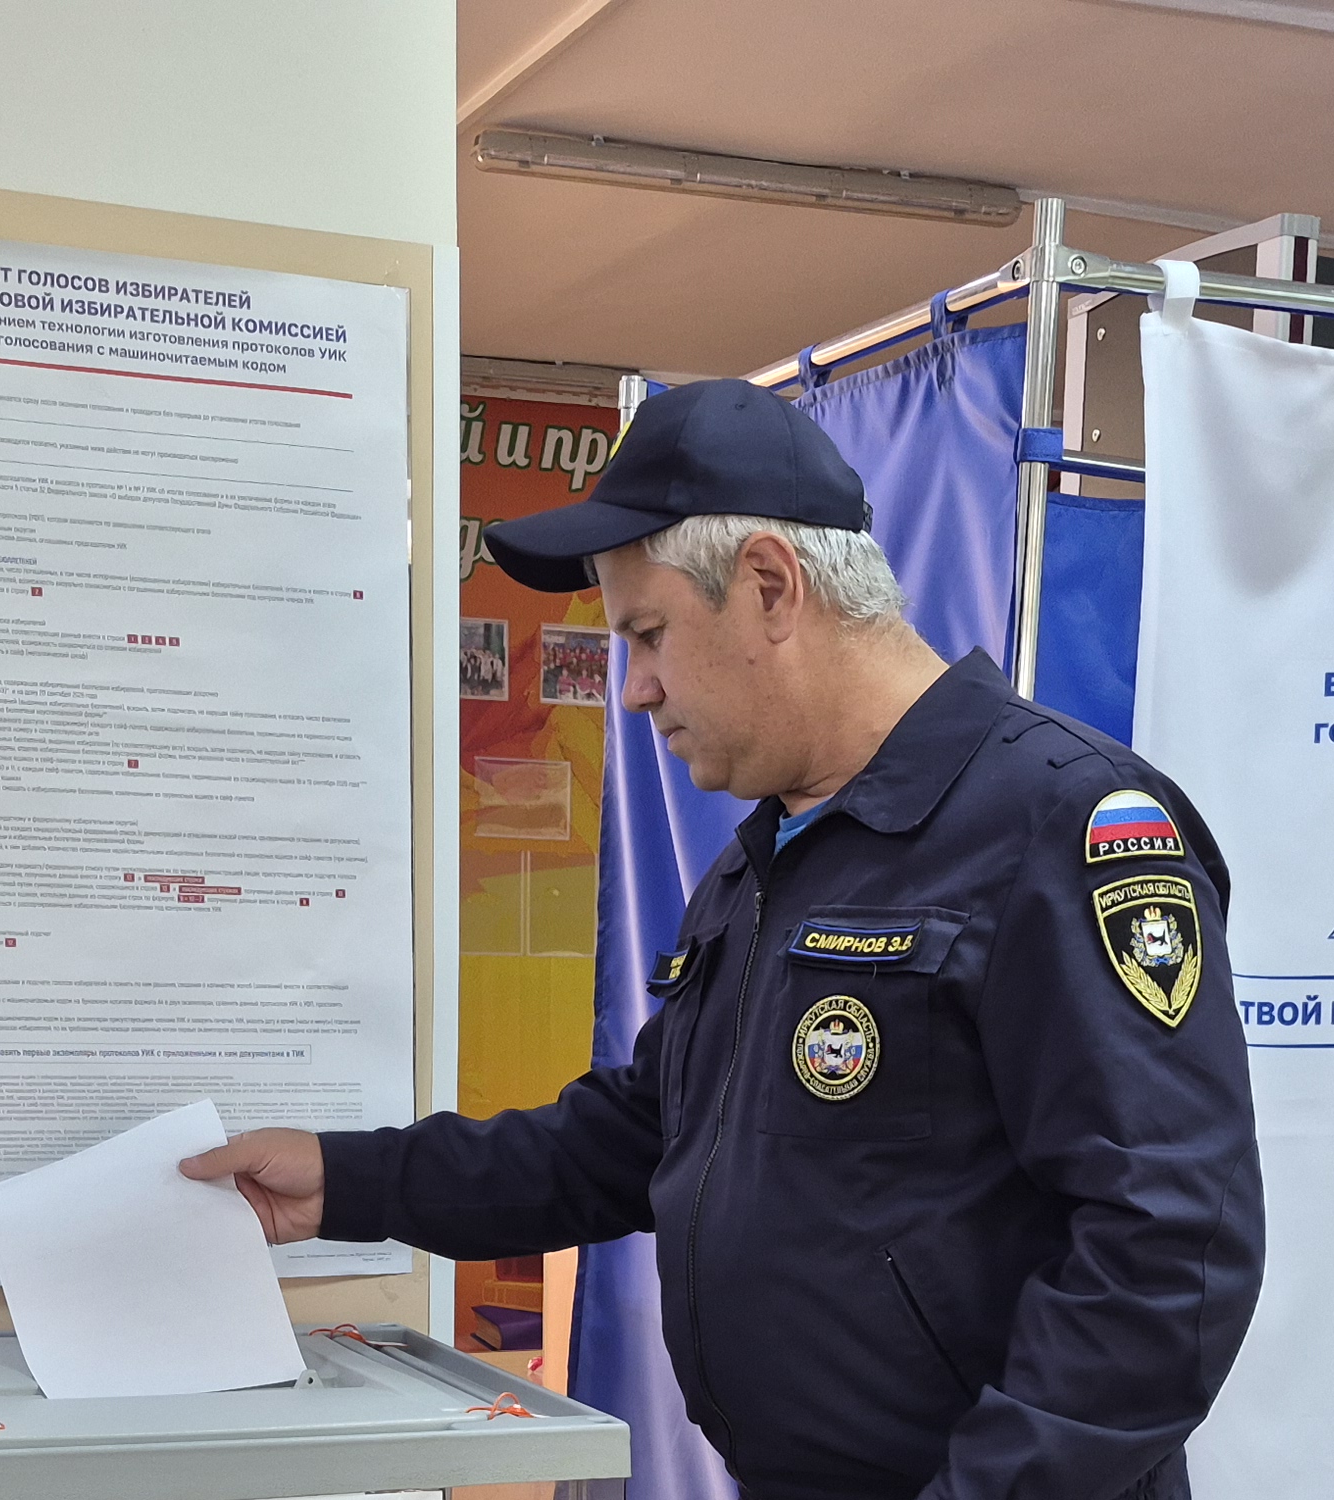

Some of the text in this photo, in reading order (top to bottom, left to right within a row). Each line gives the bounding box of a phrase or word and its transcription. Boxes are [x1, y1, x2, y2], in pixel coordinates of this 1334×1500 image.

[17, 269, 110, 294] ГОЛОСОВ
[115, 279, 252, 311] ИЗБИРАТЕЛЕЙ
[60, 297, 227, 331] ИЗБИРАТЕЛЬНОЙ
[231, 317, 347, 343] КОМИССИЕЙ
[40, 319, 125, 339] технологии
[129, 330, 228, 350] изготовления
[232, 340, 315, 358] протоколов
[318, 347, 347, 362] УИК
[97, 345, 105, 355] с
[108, 346, 239, 369] машиночитаемым
[242, 359, 286, 374] кодом
[540, 427, 609, 490] пр
[1099, 837, 1175, 856] РОССИЯ
[1100, 882, 1190, 908] ИРКУТСКАЯ ОБЛАСТЬ
[805, 933, 887, 952] СМИРНОВ
[799, 1000, 875, 1042] ИРКУТСКАЯ ОБЛАСТЬ
[1239, 994, 1321, 1026] ТВОЙ
[141, 1049, 155, 1057] УИК
[292, 1050, 305, 1058] ТИК
